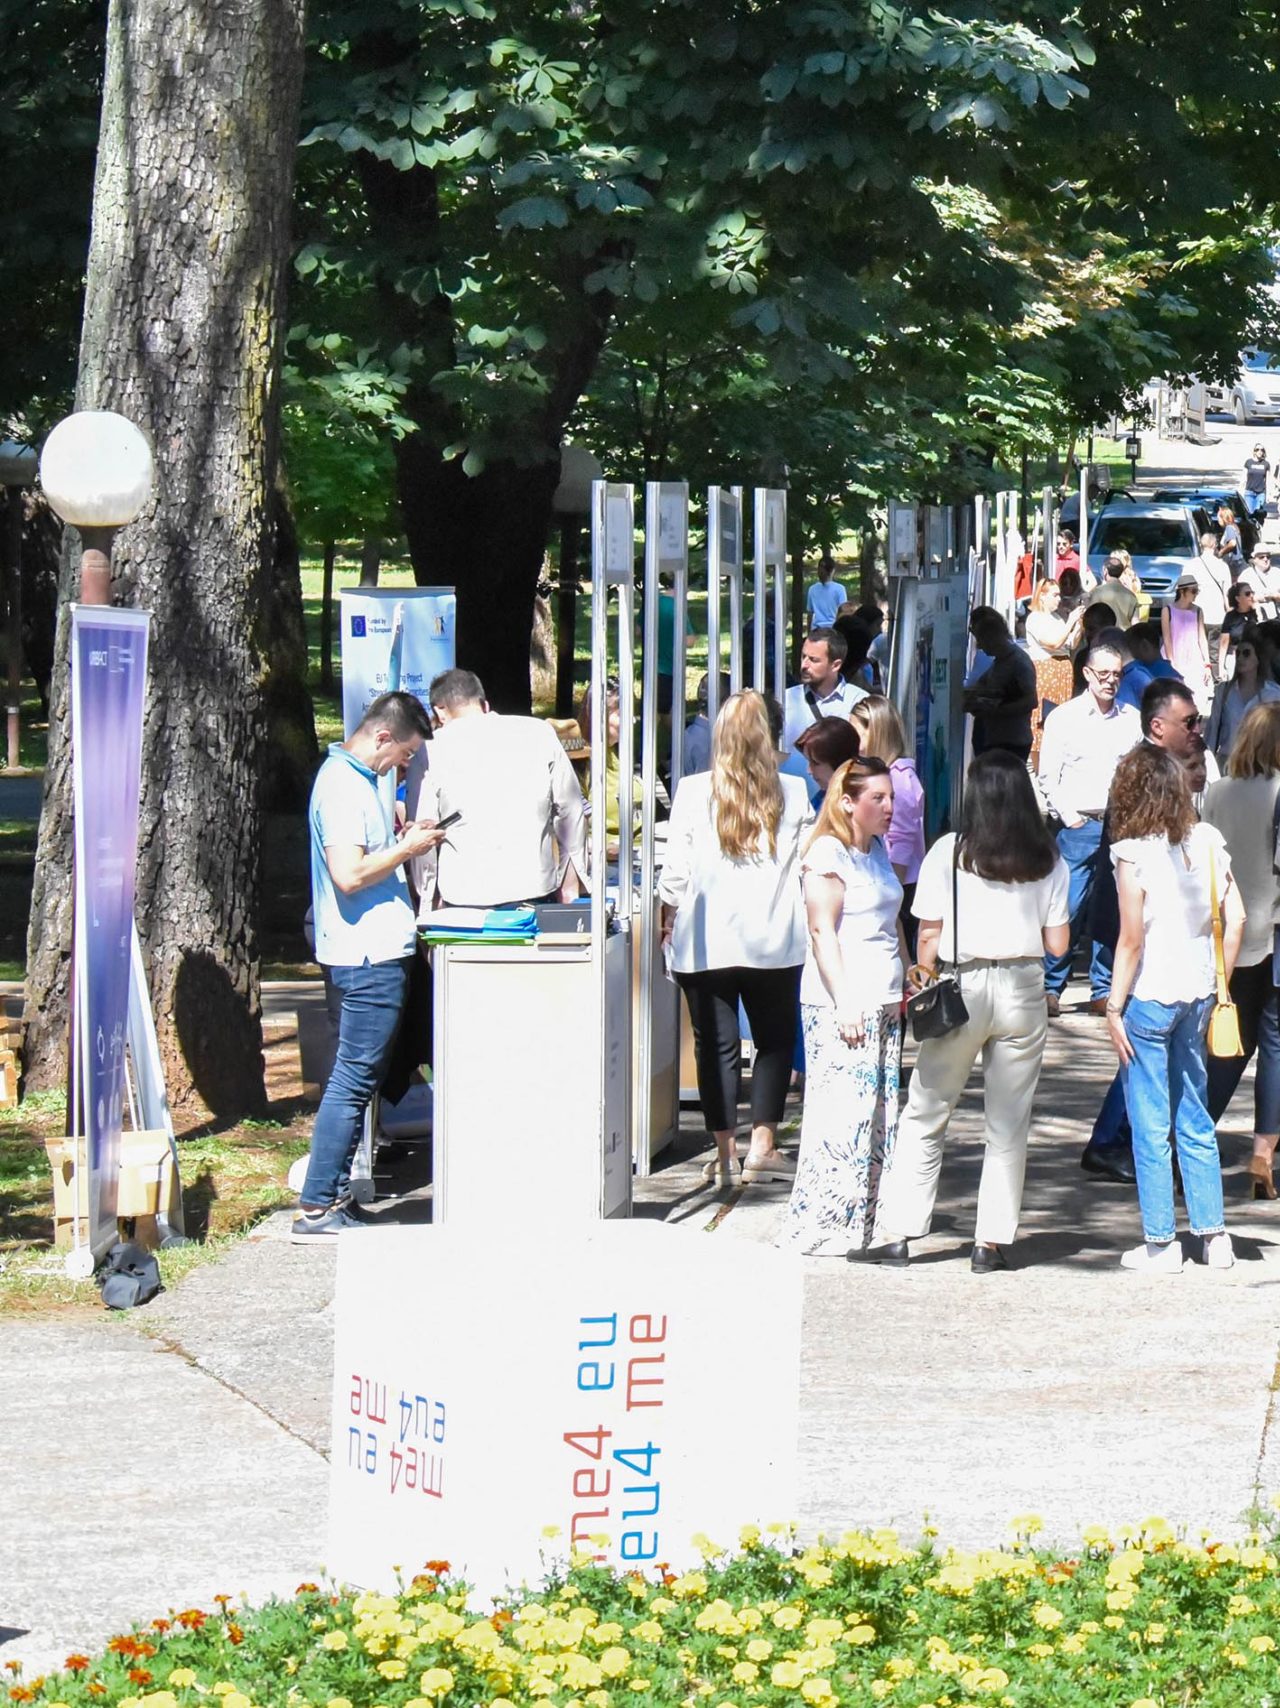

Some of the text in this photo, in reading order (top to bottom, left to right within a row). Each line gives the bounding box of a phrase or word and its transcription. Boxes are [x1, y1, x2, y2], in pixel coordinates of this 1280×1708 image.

[577, 1312, 617, 1391] eu
[350, 1374, 446, 1444] eu4 me
[613, 1313, 667, 1560] eu4 me
[349, 1426, 444, 1499] me4 eu
